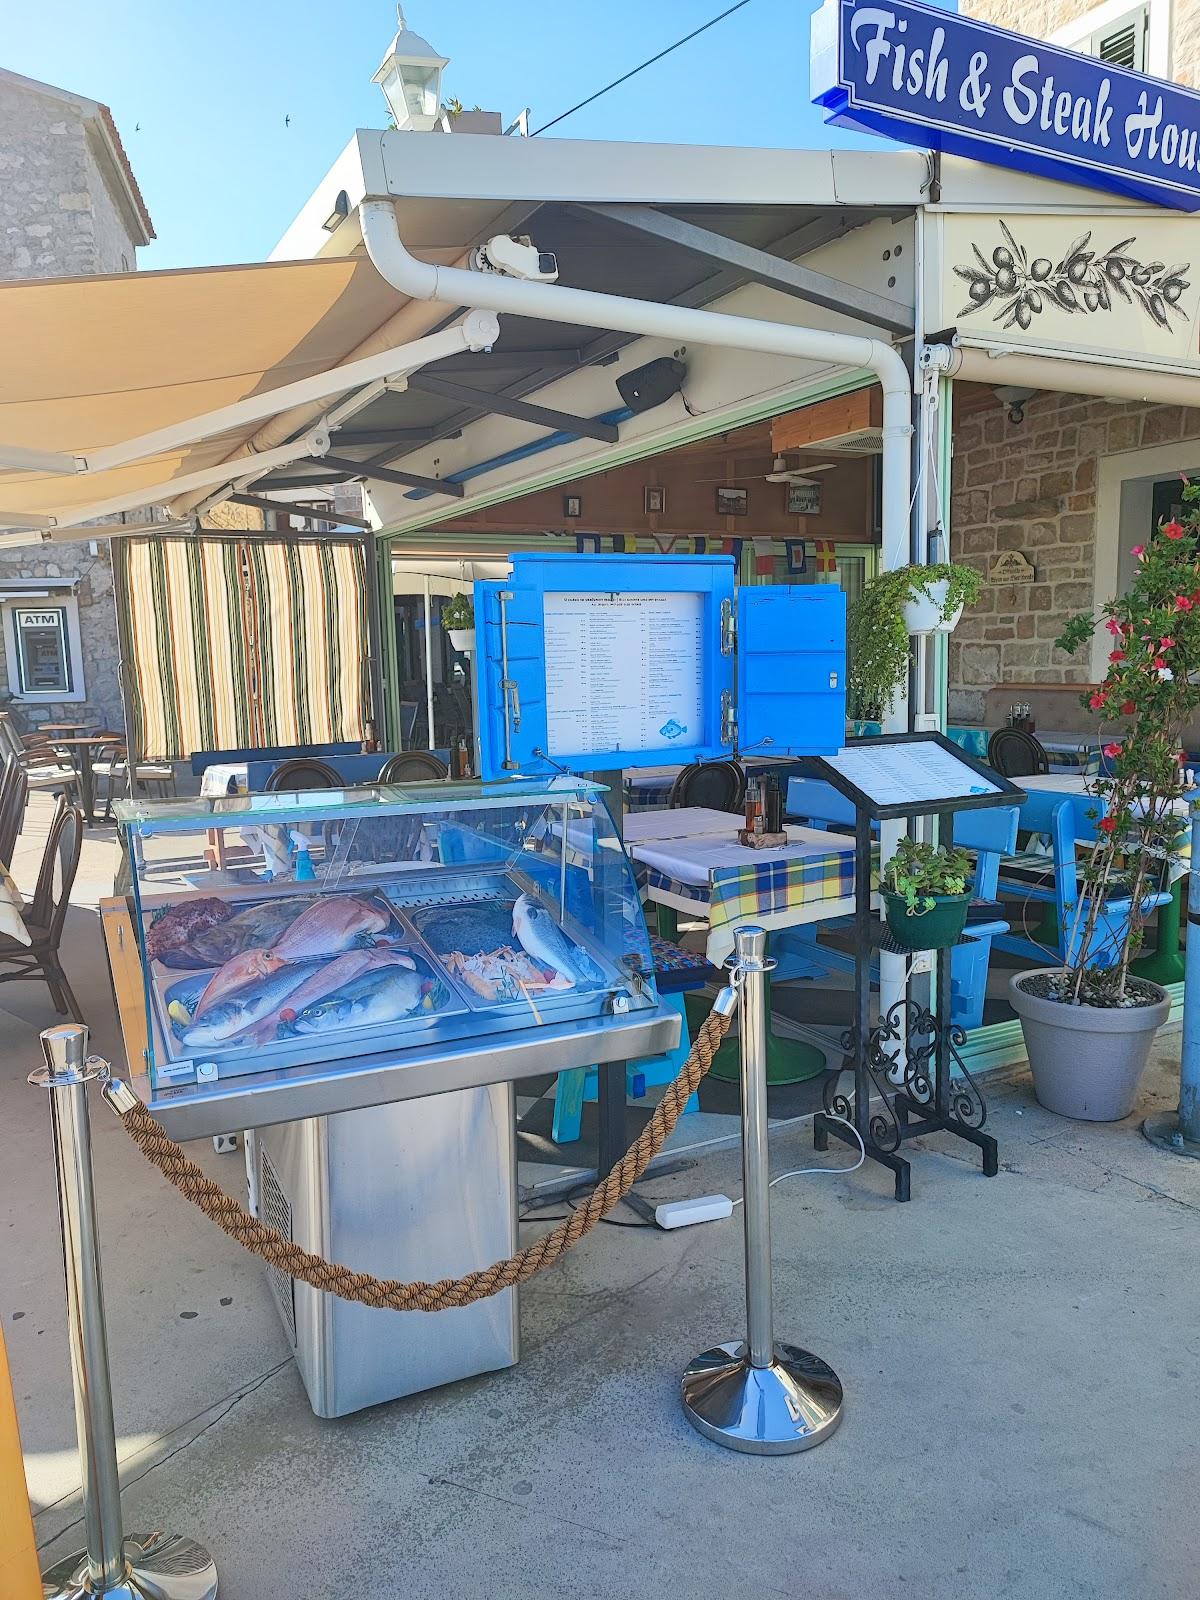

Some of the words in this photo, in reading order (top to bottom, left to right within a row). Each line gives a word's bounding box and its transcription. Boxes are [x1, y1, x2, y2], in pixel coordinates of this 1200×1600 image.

[850, 8, 949, 102] Fish
[959, 51, 991, 118] &
[1003, 55, 1114, 147] Steak
[1124, 91, 1200, 173] Hou
[25, 615, 55, 624] ATM
